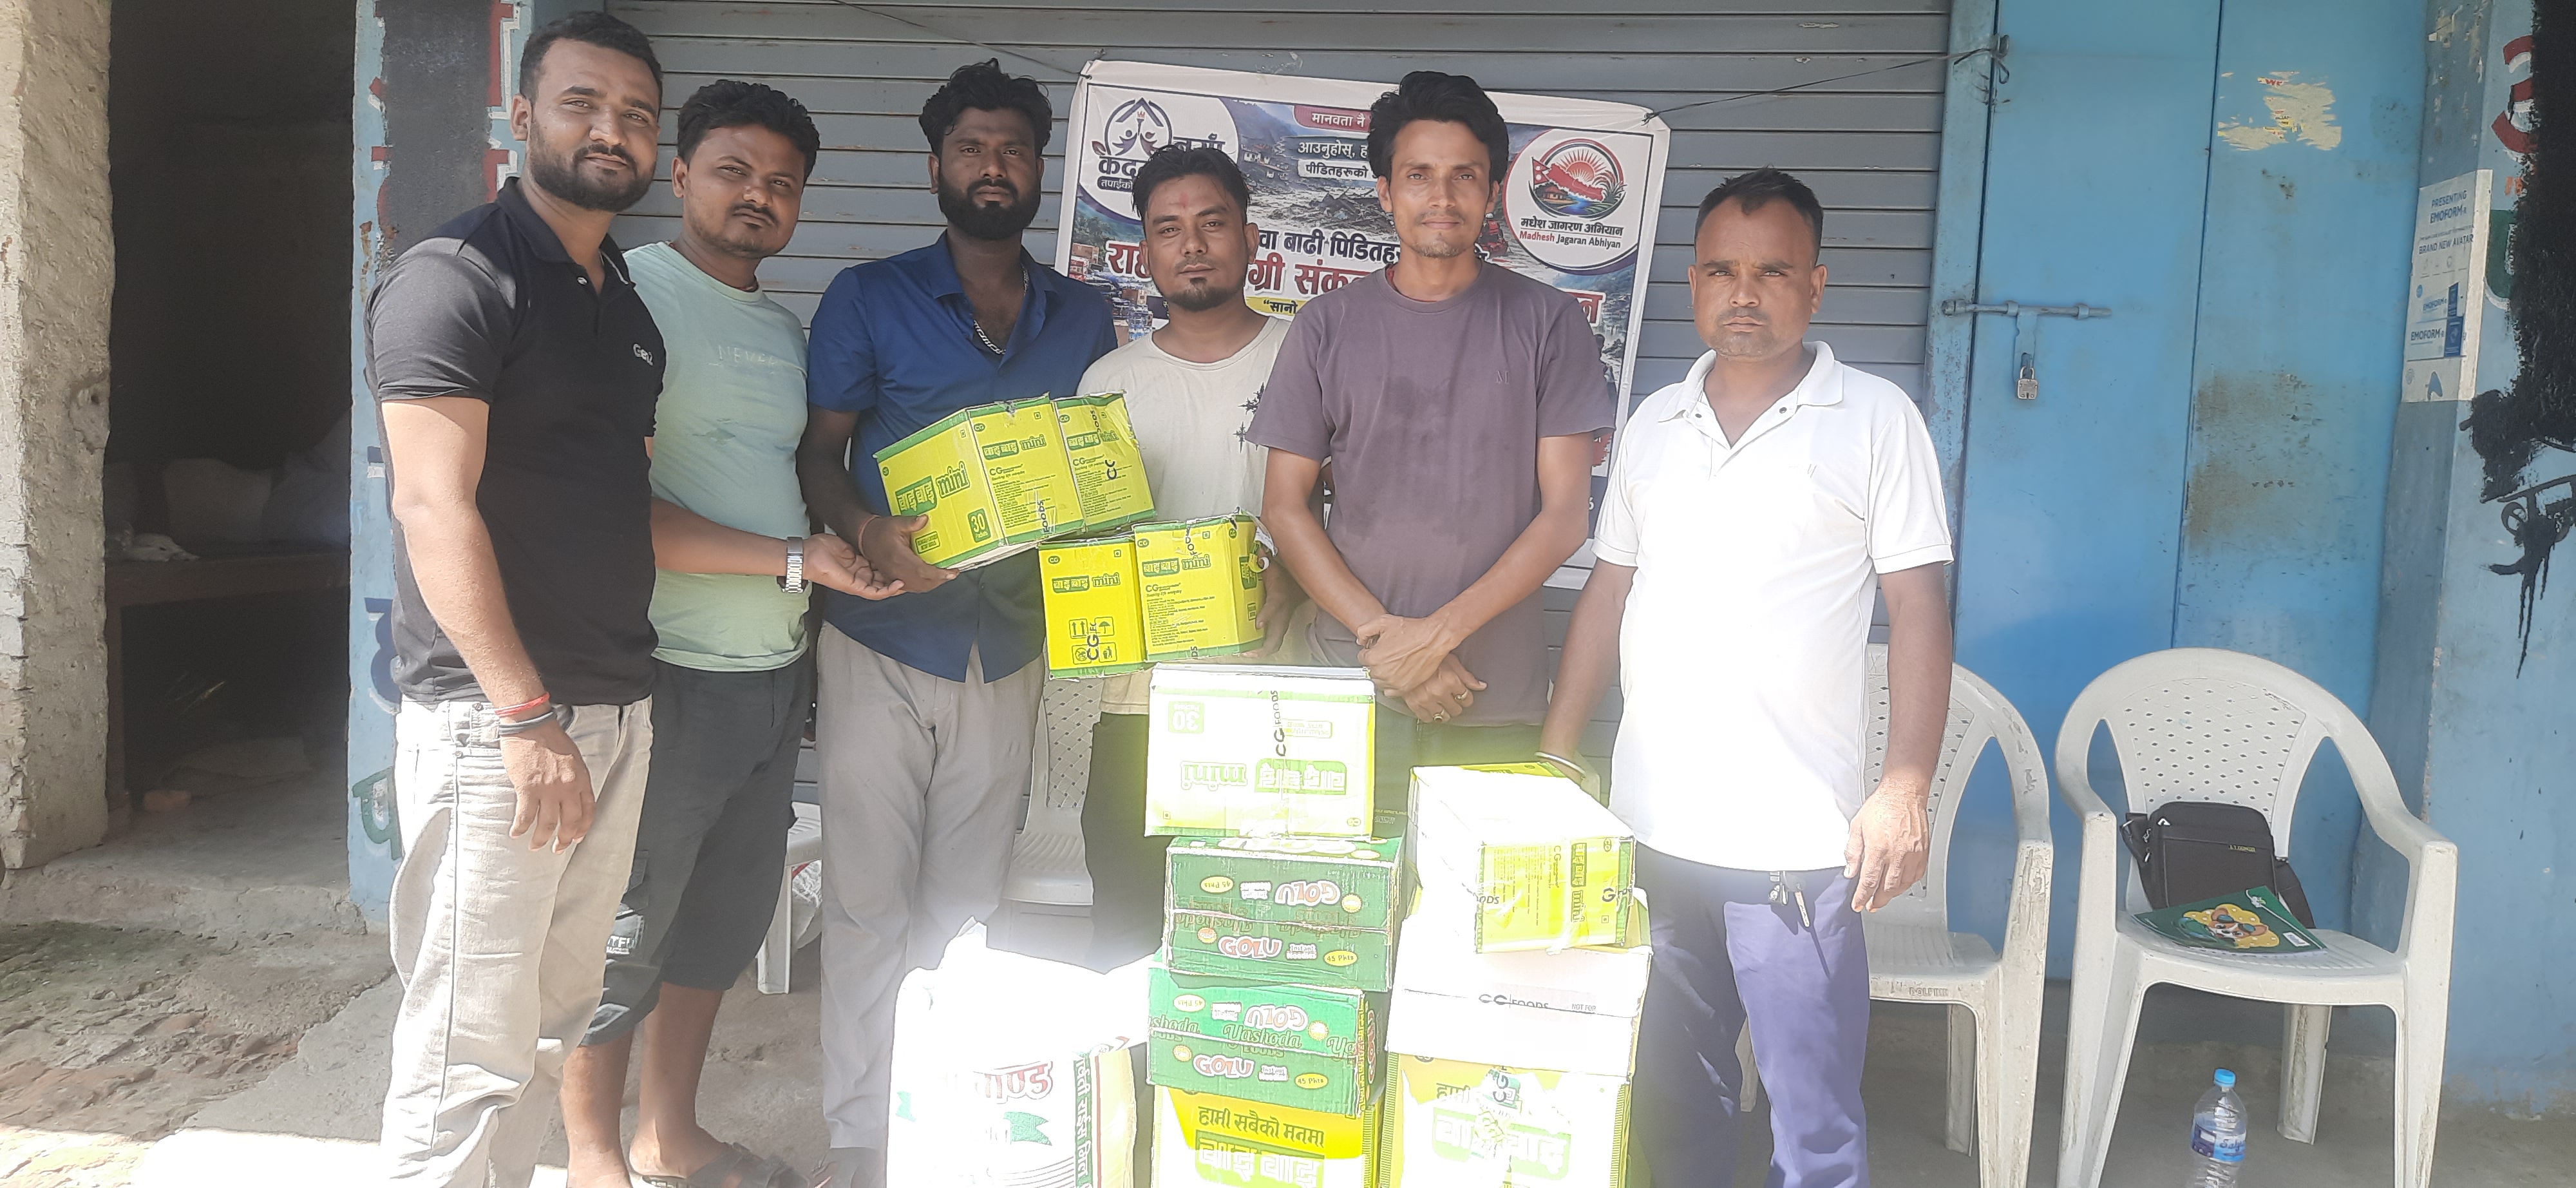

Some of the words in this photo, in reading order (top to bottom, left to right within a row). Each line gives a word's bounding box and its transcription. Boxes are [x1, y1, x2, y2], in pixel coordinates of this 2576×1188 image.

[1312, 113, 1353, 127] मानवता
[1356, 113, 1365, 128] नै
[2432, 190, 2467, 207] PRESENTING
[1520, 216, 1546, 229] मधेश
[1548, 220, 1583, 231] जागरण
[1584, 222, 1624, 236] अभियान
[1284, 229, 1325, 255] बाढी
[1520, 231, 1555, 242] Madhesh
[1556, 234, 1587, 245] Jagaran
[1588, 237, 1622, 250] Abhiyan
[2419, 243, 2438, 254] BRAND
[2439, 240, 2452, 249] NEW
[2452, 234, 2474, 245] AVATAR
[1020, 434, 1046, 450] mini
[936, 462, 970, 498] mini
[971, 513, 985, 533] 30
[1182, 554, 1211, 570] mini
[1092, 572, 1121, 587] mini
[1173, 711, 1199, 731] 30
[1180, 761, 1247, 790] mini
[1276, 881, 1340, 905] GOLU
[1219, 937, 1282, 958] GOLU
[1245, 1005, 1308, 1030] GOLU
[1193, 1055, 1255, 1078] GOLU
[1198, 1106, 1231, 1129] हामी
[1234, 1109, 1280, 1139] सबैको
